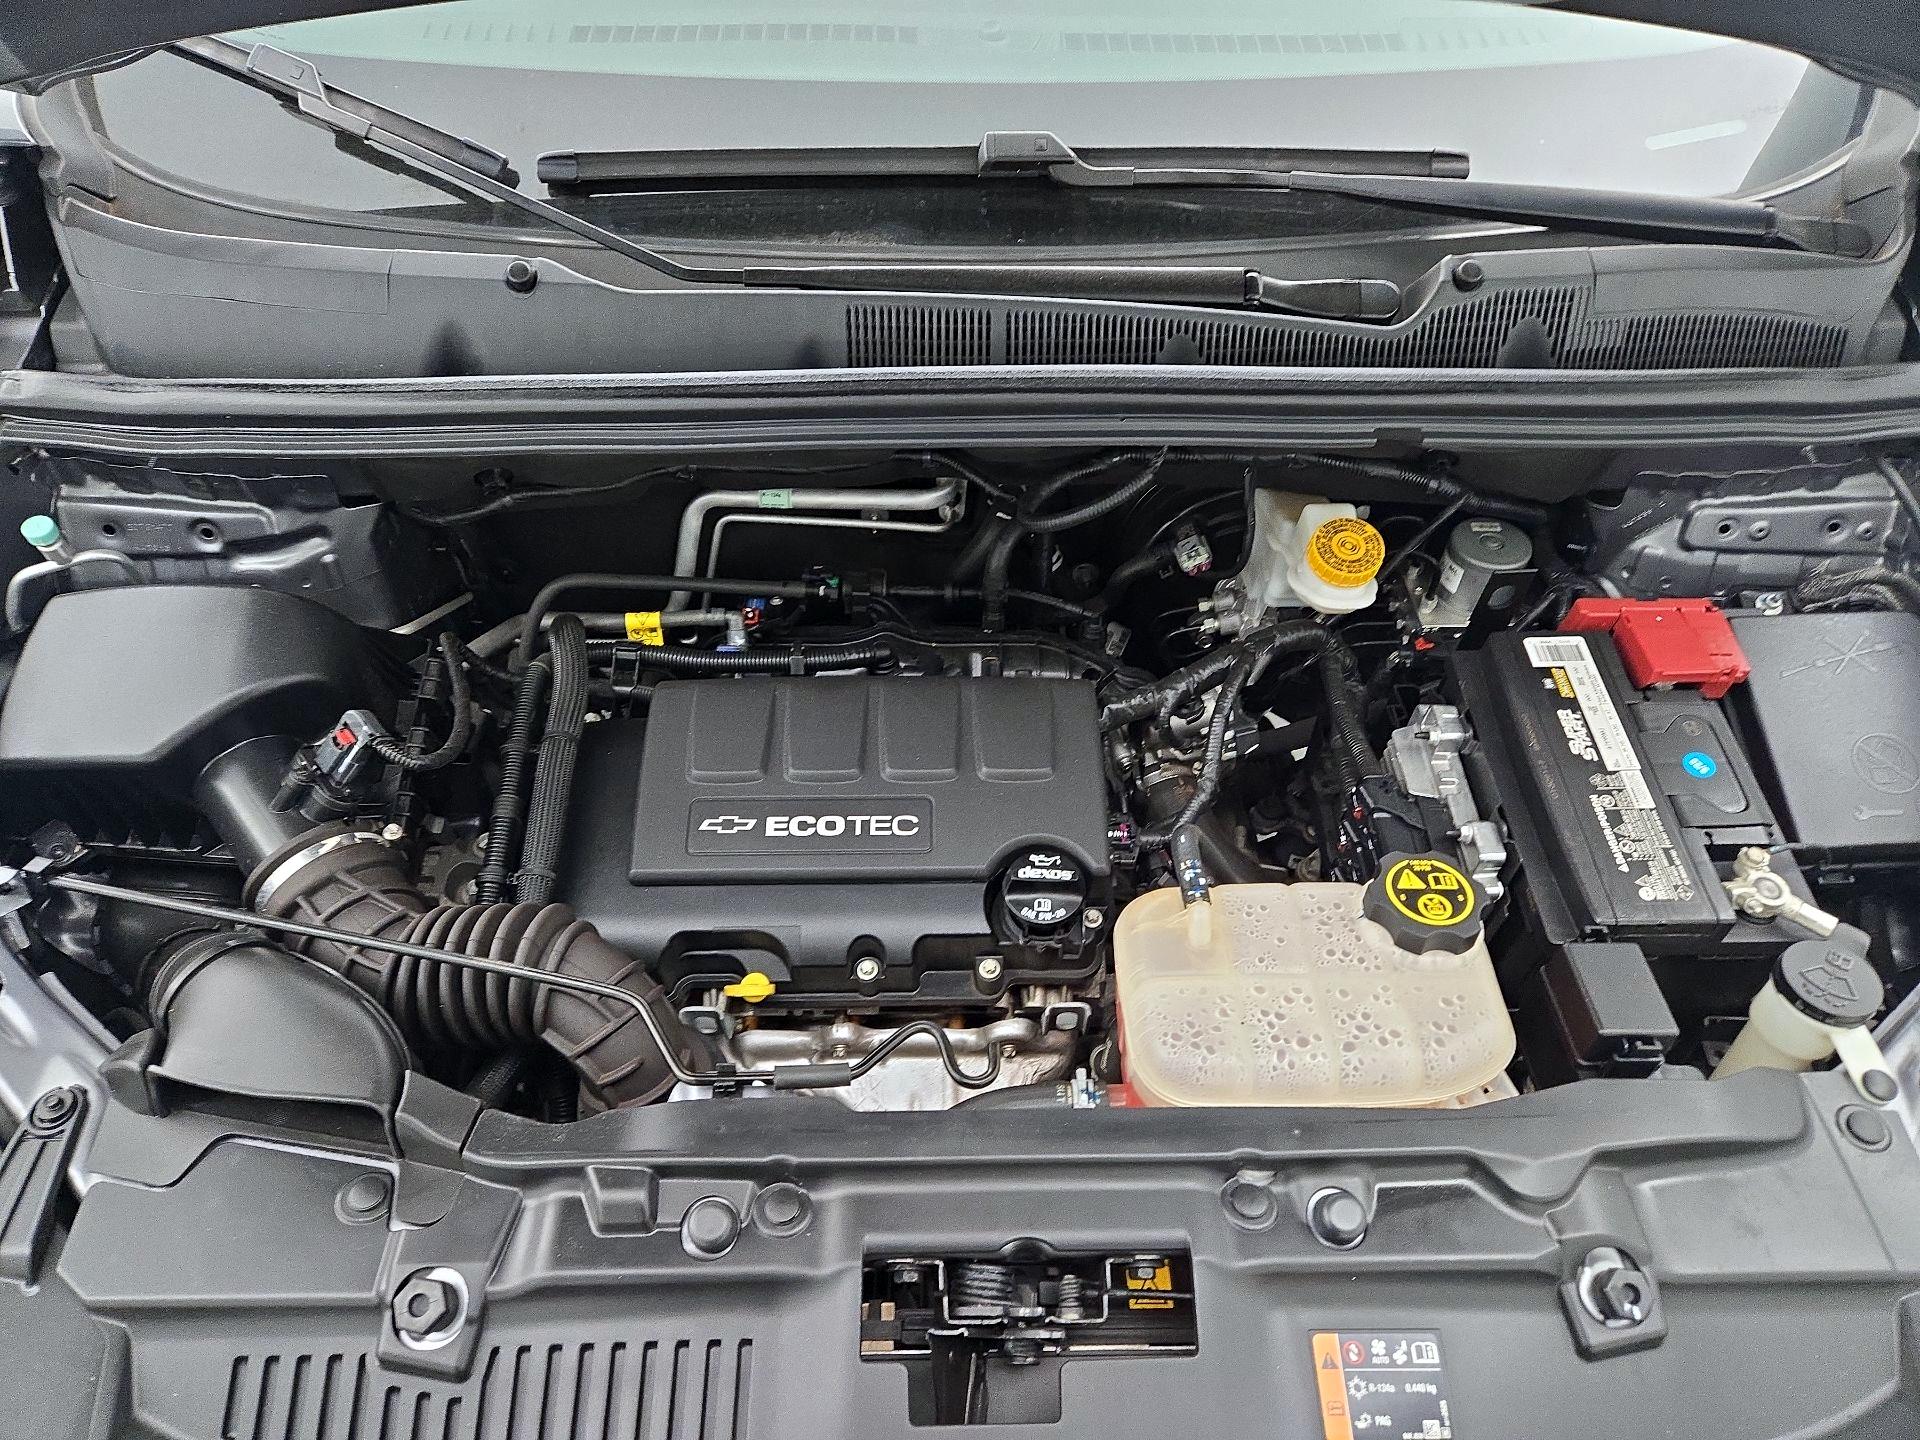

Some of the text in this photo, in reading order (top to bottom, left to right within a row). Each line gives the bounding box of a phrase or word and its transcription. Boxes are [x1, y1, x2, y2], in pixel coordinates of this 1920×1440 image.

[1556, 708, 1584, 756] SUPER
[1571, 711, 1599, 762] START
[765, 815, 920, 837] ECOTEC
[1588, 794, 1626, 865] DANGER/POISON
[1017, 865, 1075, 880] dexos
